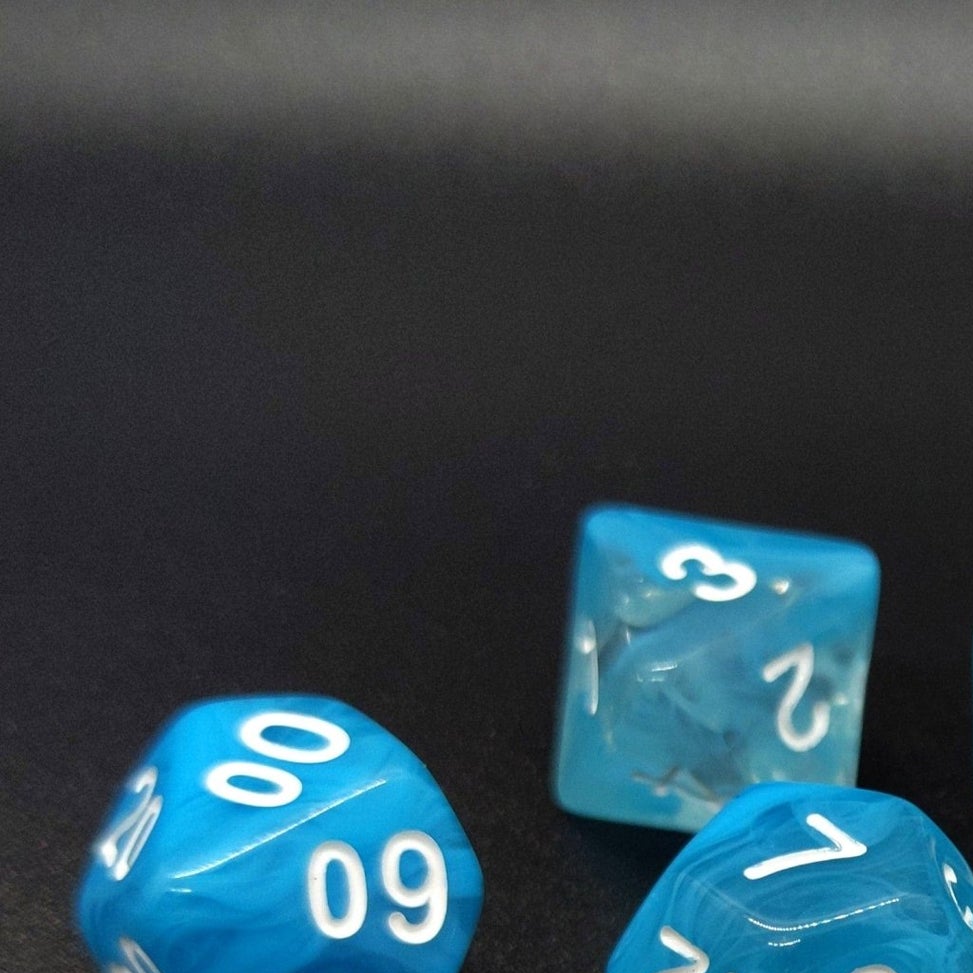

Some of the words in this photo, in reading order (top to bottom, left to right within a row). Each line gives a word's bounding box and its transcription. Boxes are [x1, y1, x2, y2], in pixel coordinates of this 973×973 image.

[657, 543, 757, 602] 3
[761, 643, 830, 751] 2
[202, 711, 351, 808] 00
